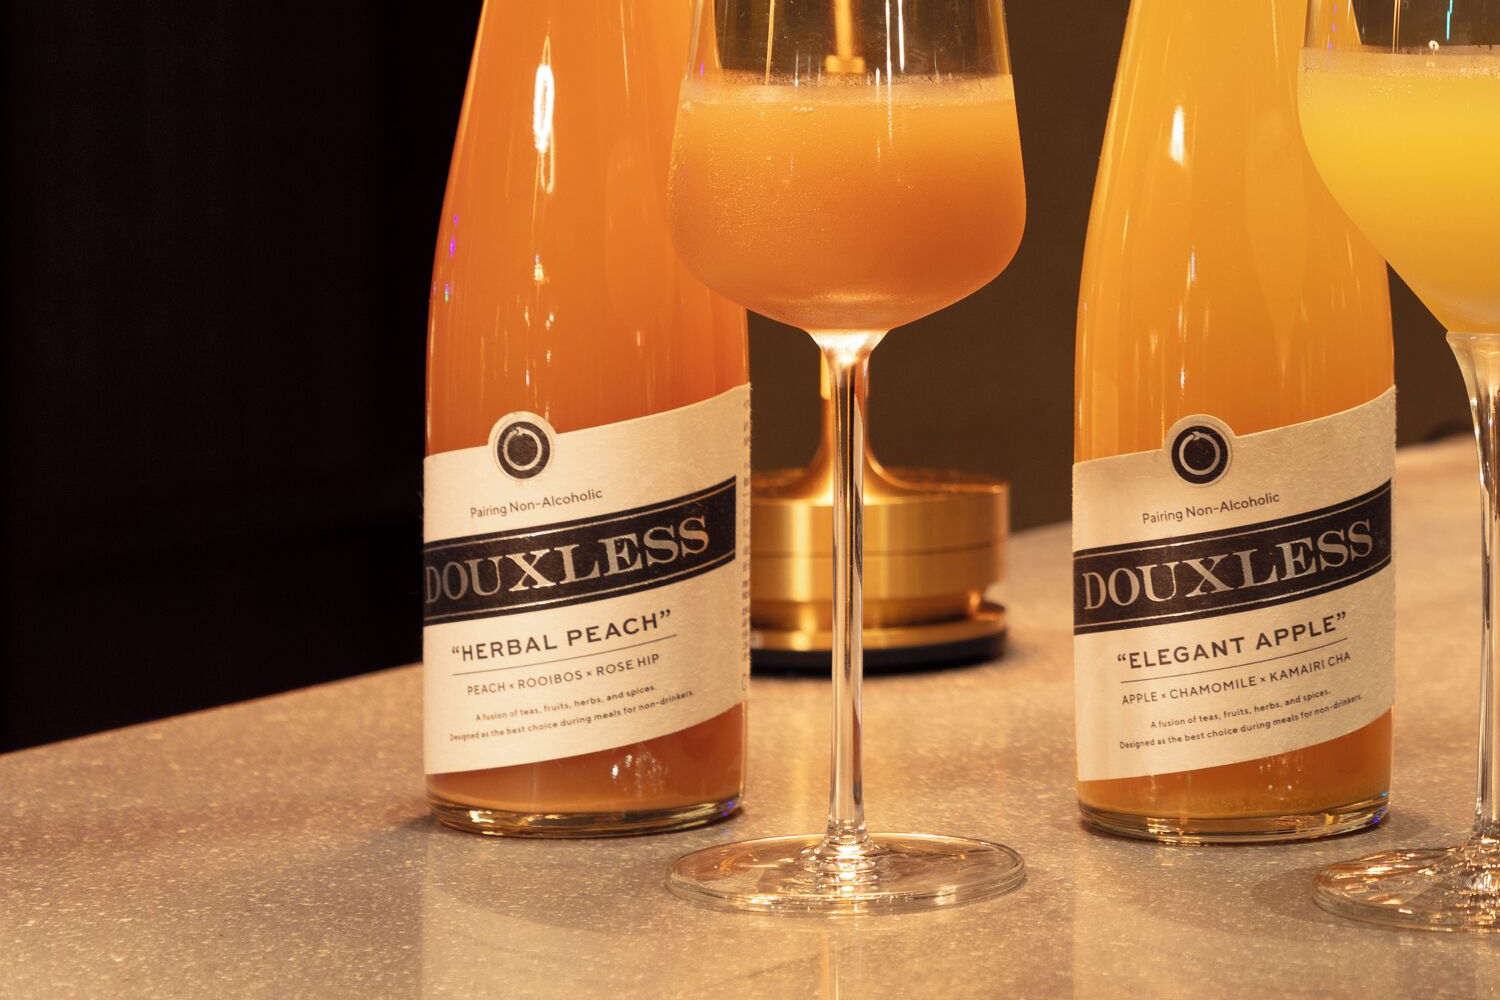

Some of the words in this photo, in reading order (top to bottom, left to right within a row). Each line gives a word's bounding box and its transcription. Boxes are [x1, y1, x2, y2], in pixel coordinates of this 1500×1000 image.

[470, 503, 507, 518] Pairing
[510, 488, 603, 513] Non-Alcoholic
[1142, 507, 1183, 524] Pairing
[1186, 492, 1280, 518] Non-Alcoholic
[425, 515, 709, 604] DOUXLESS
[1082, 519, 1374, 610] DOUXLESS
[467, 682, 505, 695] PEACH
[518, 670, 583, 689] ROOIBOS
[596, 660, 634, 676] ROSE
[637, 653, 660, 667] HIP
[1122, 692, 1158, 705] APPLE
[1169, 676, 1257, 699] CHAMOMILE
[1269, 660, 1325, 682] KAMAIRI
[1328, 651, 1351, 667] CHA
[450, 731, 479, 741] Designed
[491, 728, 504, 736] the
[506, 726, 525, 735] best
[527, 722, 558, 731] choice
[560, 716, 591, 727] during
[594, 710, 621, 721] meals
[623, 706, 636, 714] for
[483, 712, 507, 720] fusion
[509, 709, 518, 717] of
[606, 692, 624, 701] and
[1151, 721, 1157, 729] A
[1158, 718, 1186, 728] fusion
[1187, 716, 1197, 724] of
[1285, 696, 1300, 706] and
[1119, 740, 1155, 750] Designed
[1168, 736, 1182, 744] the
[1184, 732, 1204, 742] best
[1207, 728, 1238, 738] choice
[1240, 720, 1271, 733] during
[1273, 713, 1299, 726] meals
[1300, 711, 1313, 719] for
